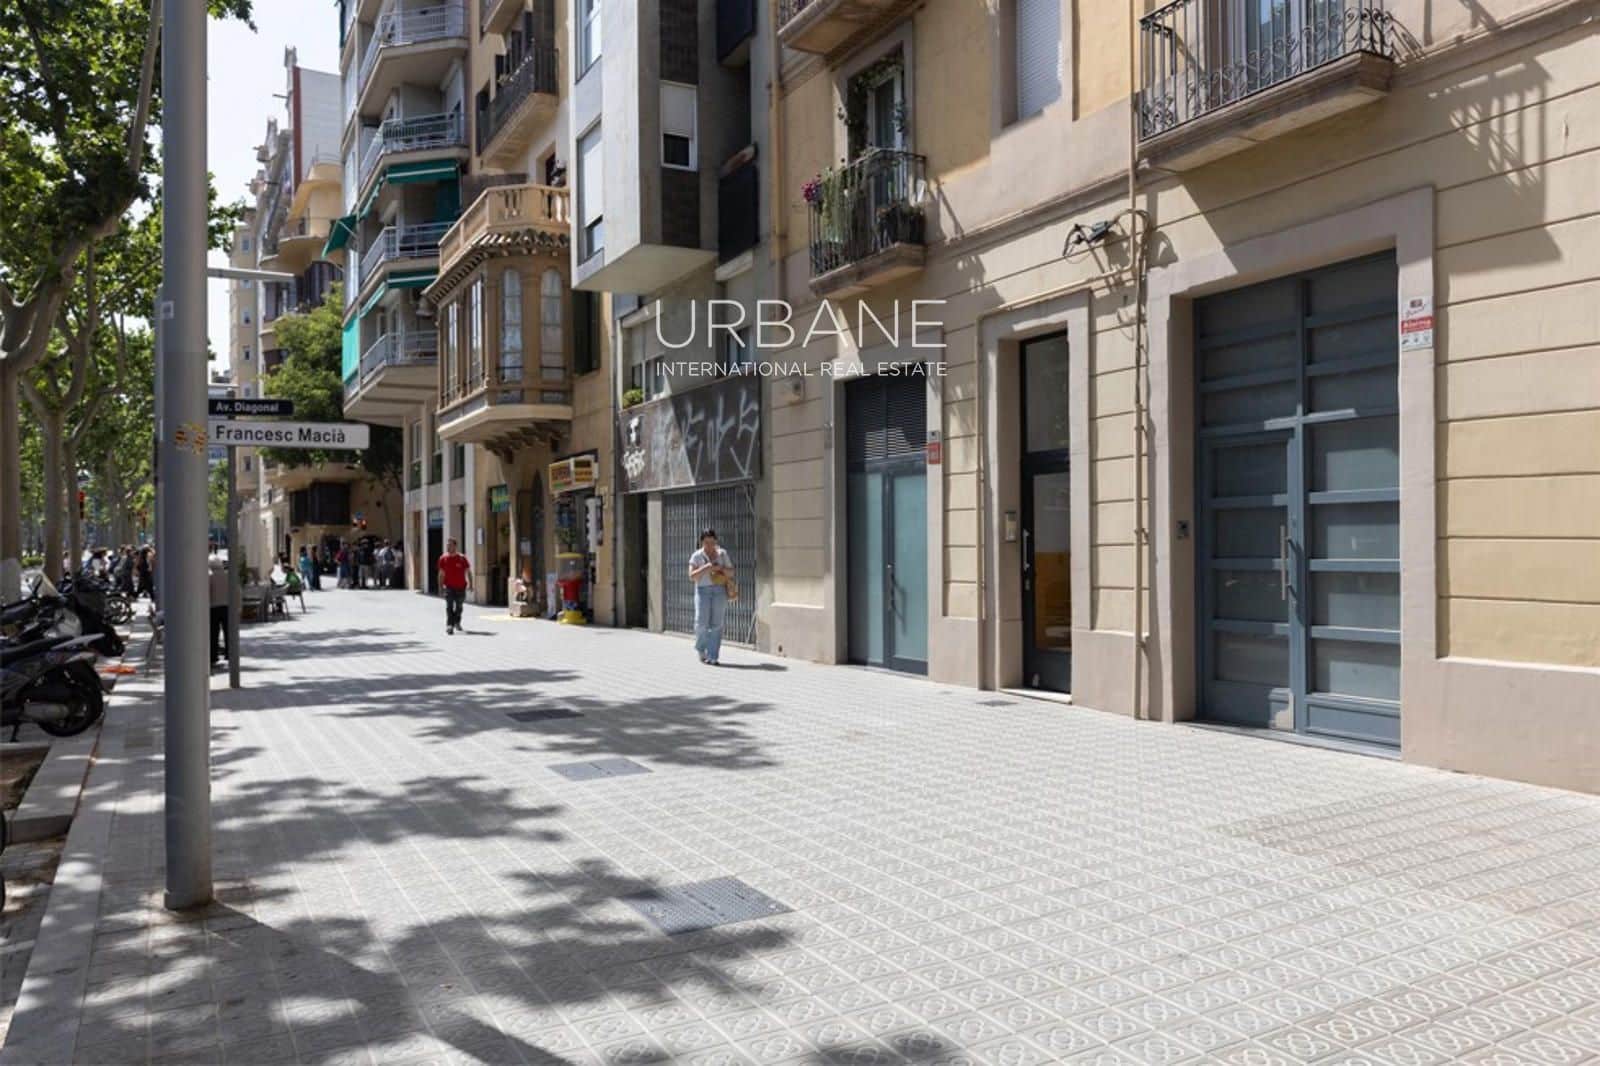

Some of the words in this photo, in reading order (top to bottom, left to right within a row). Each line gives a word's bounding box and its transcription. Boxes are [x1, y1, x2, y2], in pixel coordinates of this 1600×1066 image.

[216, 401, 233, 412] Av.
[234, 401, 280, 414] Diagonal
[215, 425, 294, 442] Francesc
[298, 426, 346, 444] Macià
